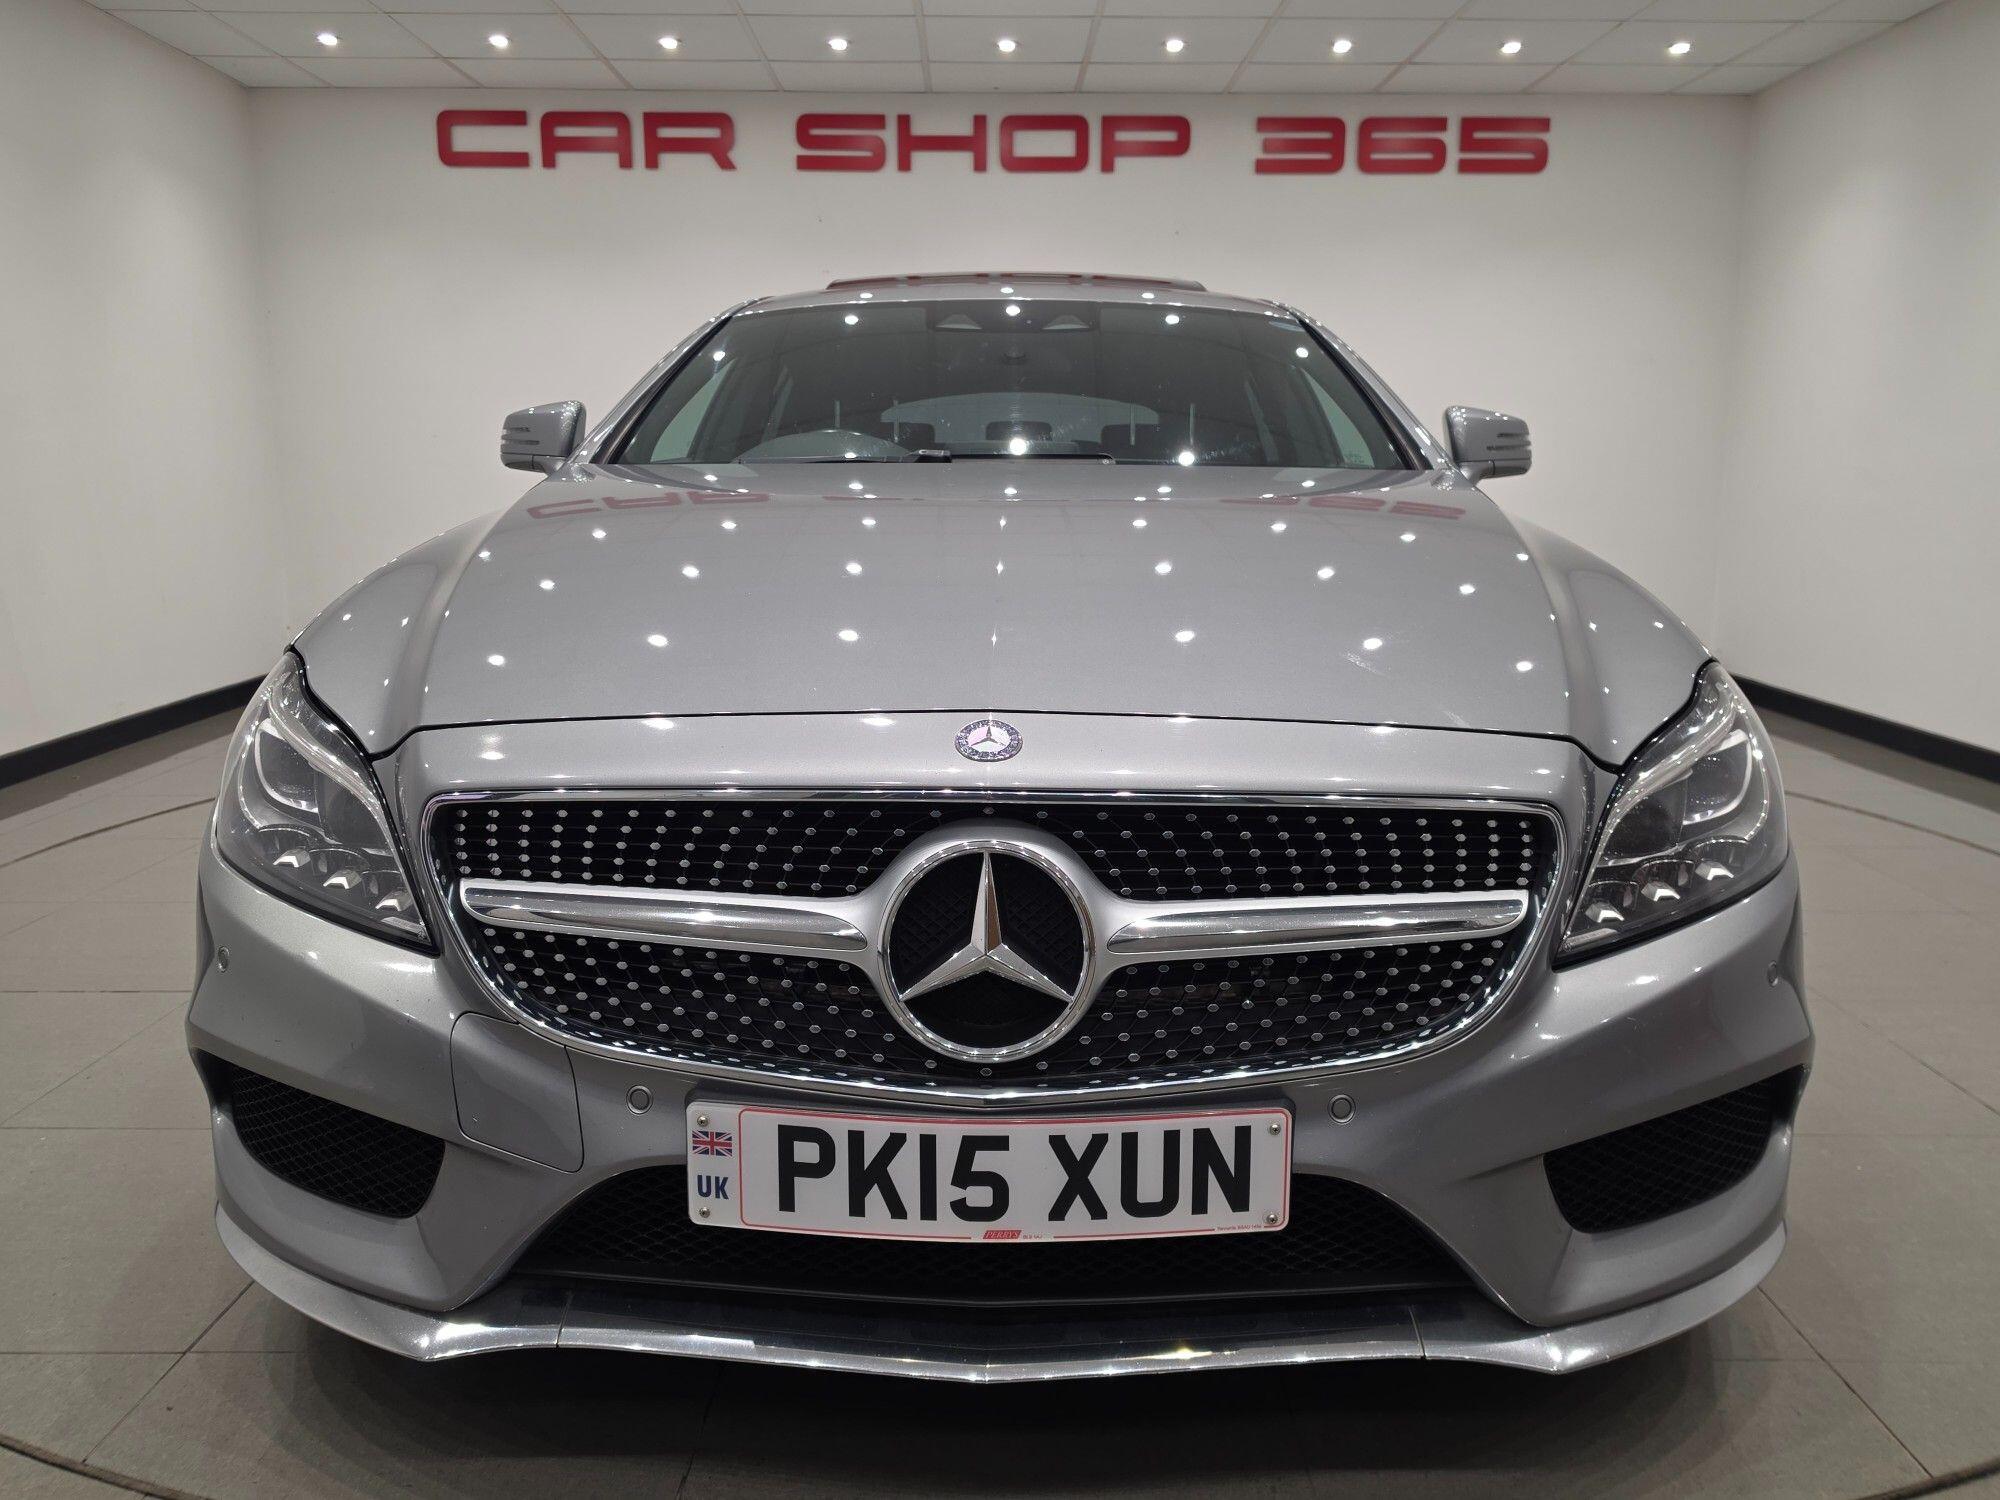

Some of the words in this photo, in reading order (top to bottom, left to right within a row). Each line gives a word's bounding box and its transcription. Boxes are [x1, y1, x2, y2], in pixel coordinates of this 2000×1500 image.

[437, 110, 735, 169] CAR
[796, 113, 1191, 171] SHOP
[1255, 117, 1550, 173] 365
[697, 1174, 730, 1200] UK
[777, 1124, 1010, 1223] PK15
[1047, 1125, 1252, 1222] XUN
[984, 1230, 1020, 1239] PERRYS
